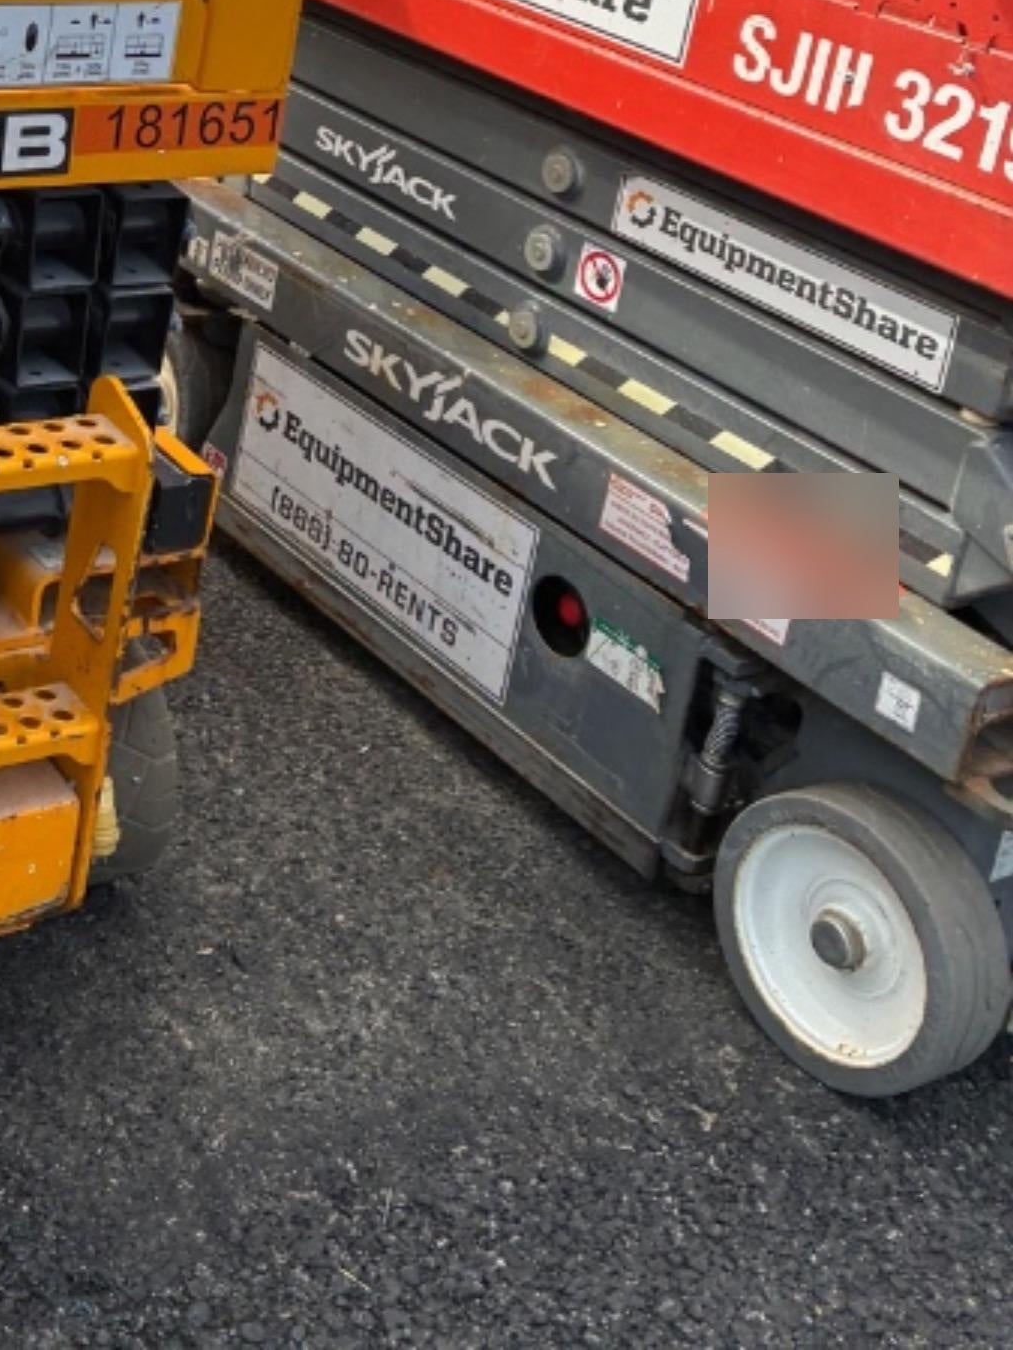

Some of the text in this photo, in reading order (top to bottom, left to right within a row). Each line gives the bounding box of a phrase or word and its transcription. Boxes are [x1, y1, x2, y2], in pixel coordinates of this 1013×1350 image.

[107, 100, 281, 150] 181651
[315, 125, 456, 221] SKYJACK
[659, 206, 938, 361] EquipmentShare
[343, 329, 559, 491] SKYJACK
[282, 410, 514, 598] EquipmentShare
